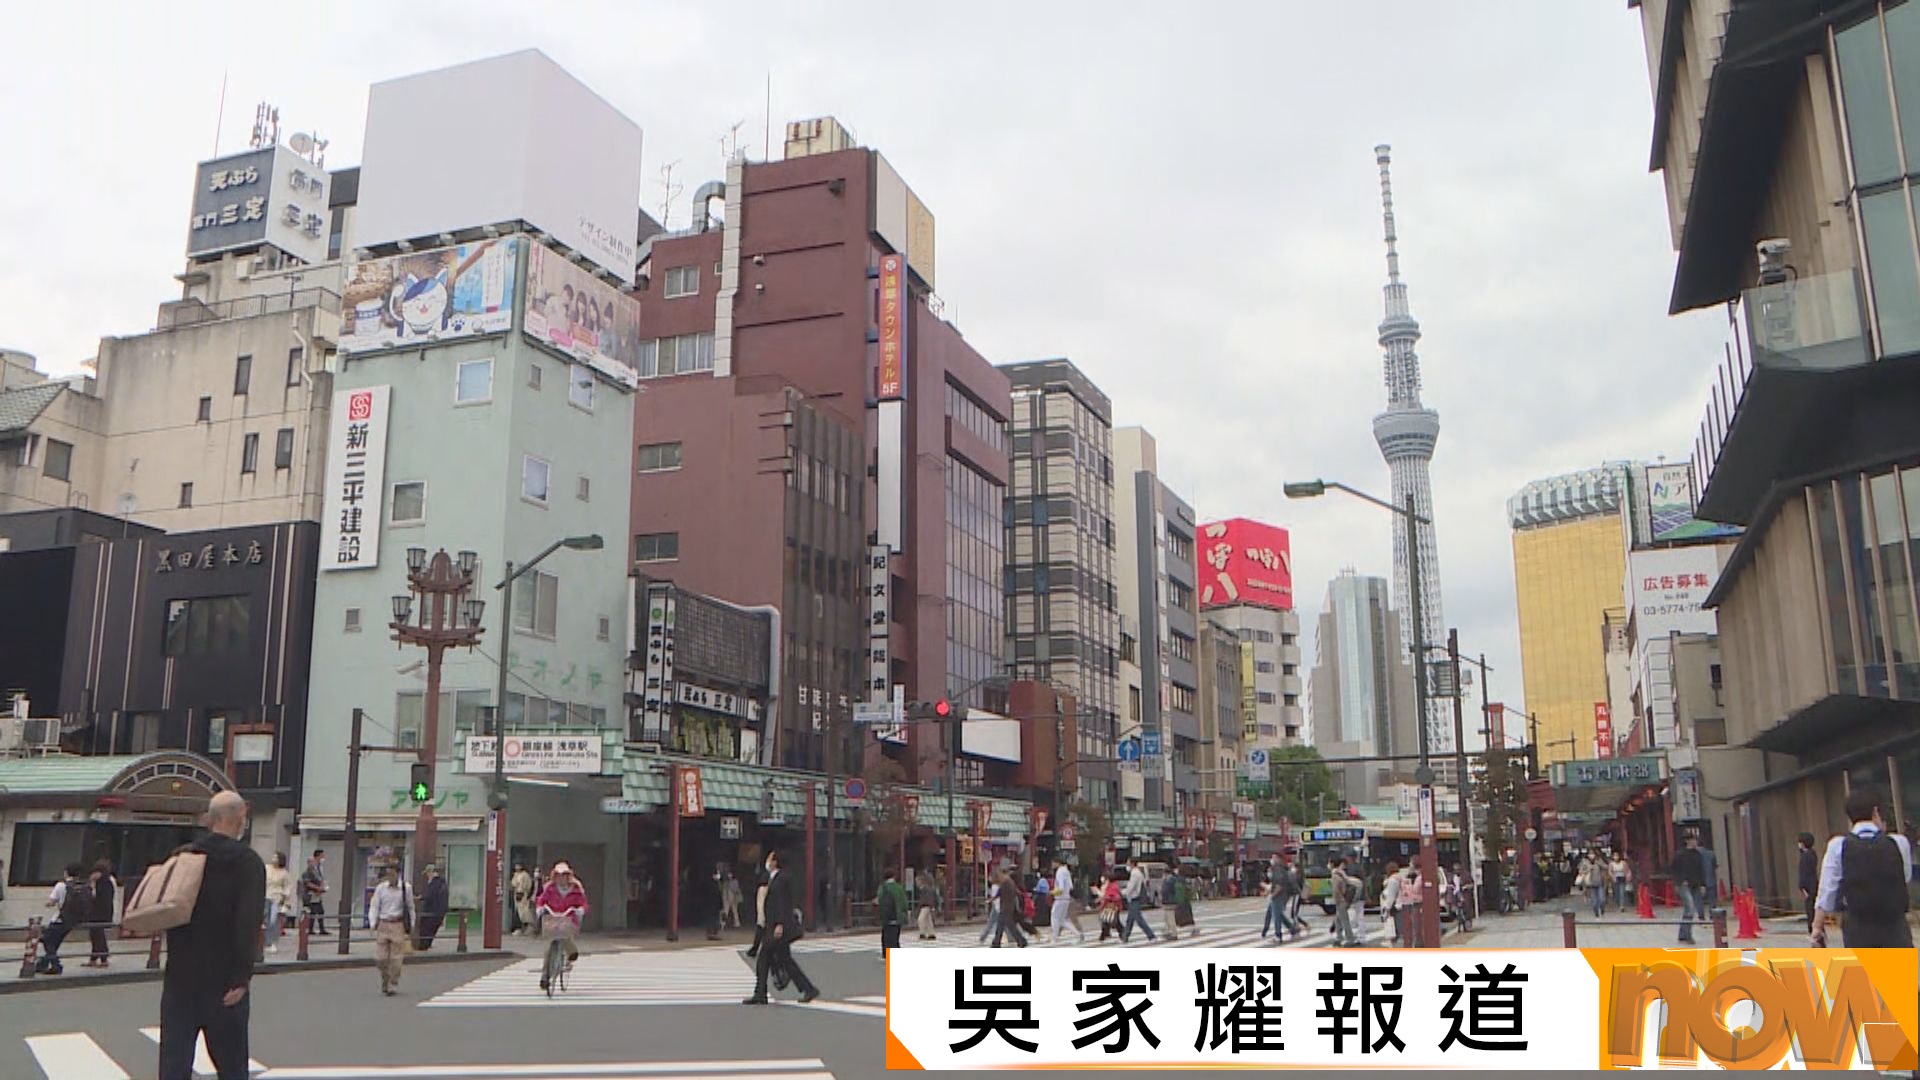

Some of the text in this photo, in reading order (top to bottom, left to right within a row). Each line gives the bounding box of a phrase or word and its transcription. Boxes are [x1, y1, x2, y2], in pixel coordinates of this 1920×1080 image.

[209, 166, 258, 192] 天ぷら
[338, 424, 369, 563] 新三平建設
[1201, 523, 1239, 603] つぼ八
[1643, 573, 1710, 592] 広告募集
